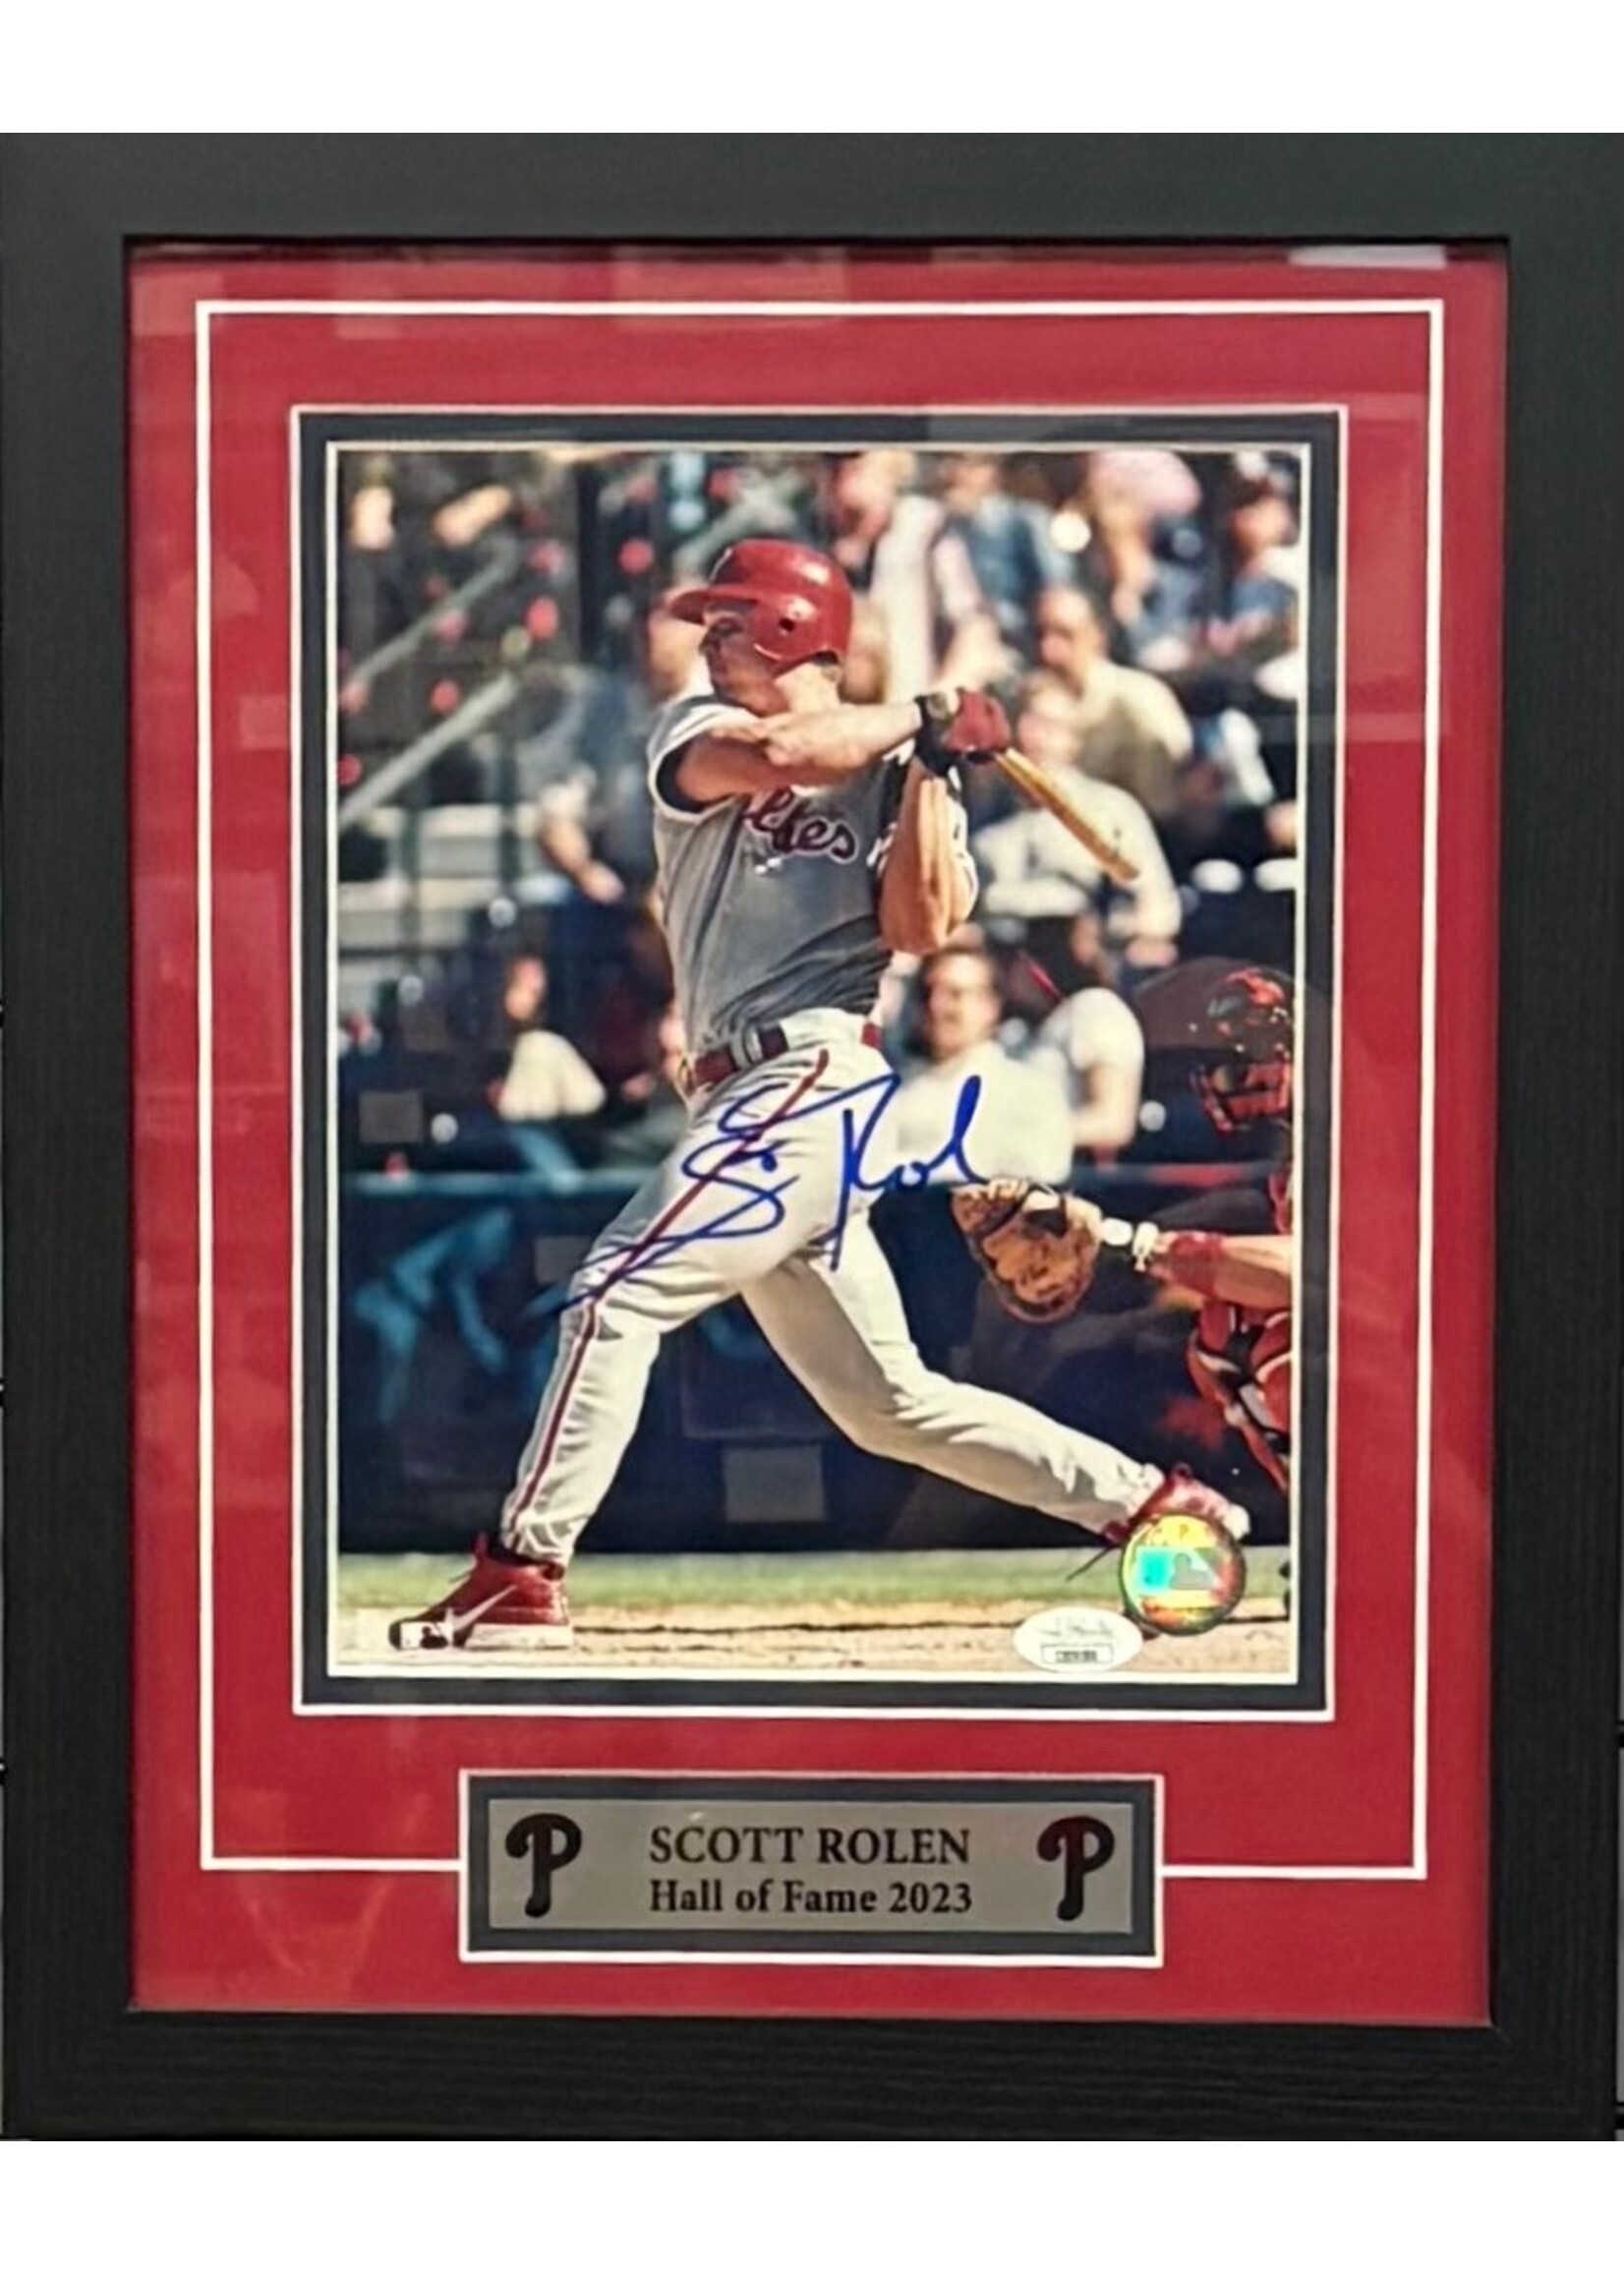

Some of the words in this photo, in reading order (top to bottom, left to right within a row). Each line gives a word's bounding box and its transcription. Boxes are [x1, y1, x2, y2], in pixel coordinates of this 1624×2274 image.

[649, 1826, 804, 1865] SCOTT
[818, 1827, 971, 1866] ROLEN
[649, 1878, 724, 1913] Hall
[735, 1878, 775, 1913] of
[783, 1880, 878, 1914] Fame
[889, 1881, 973, 1915] 2023
